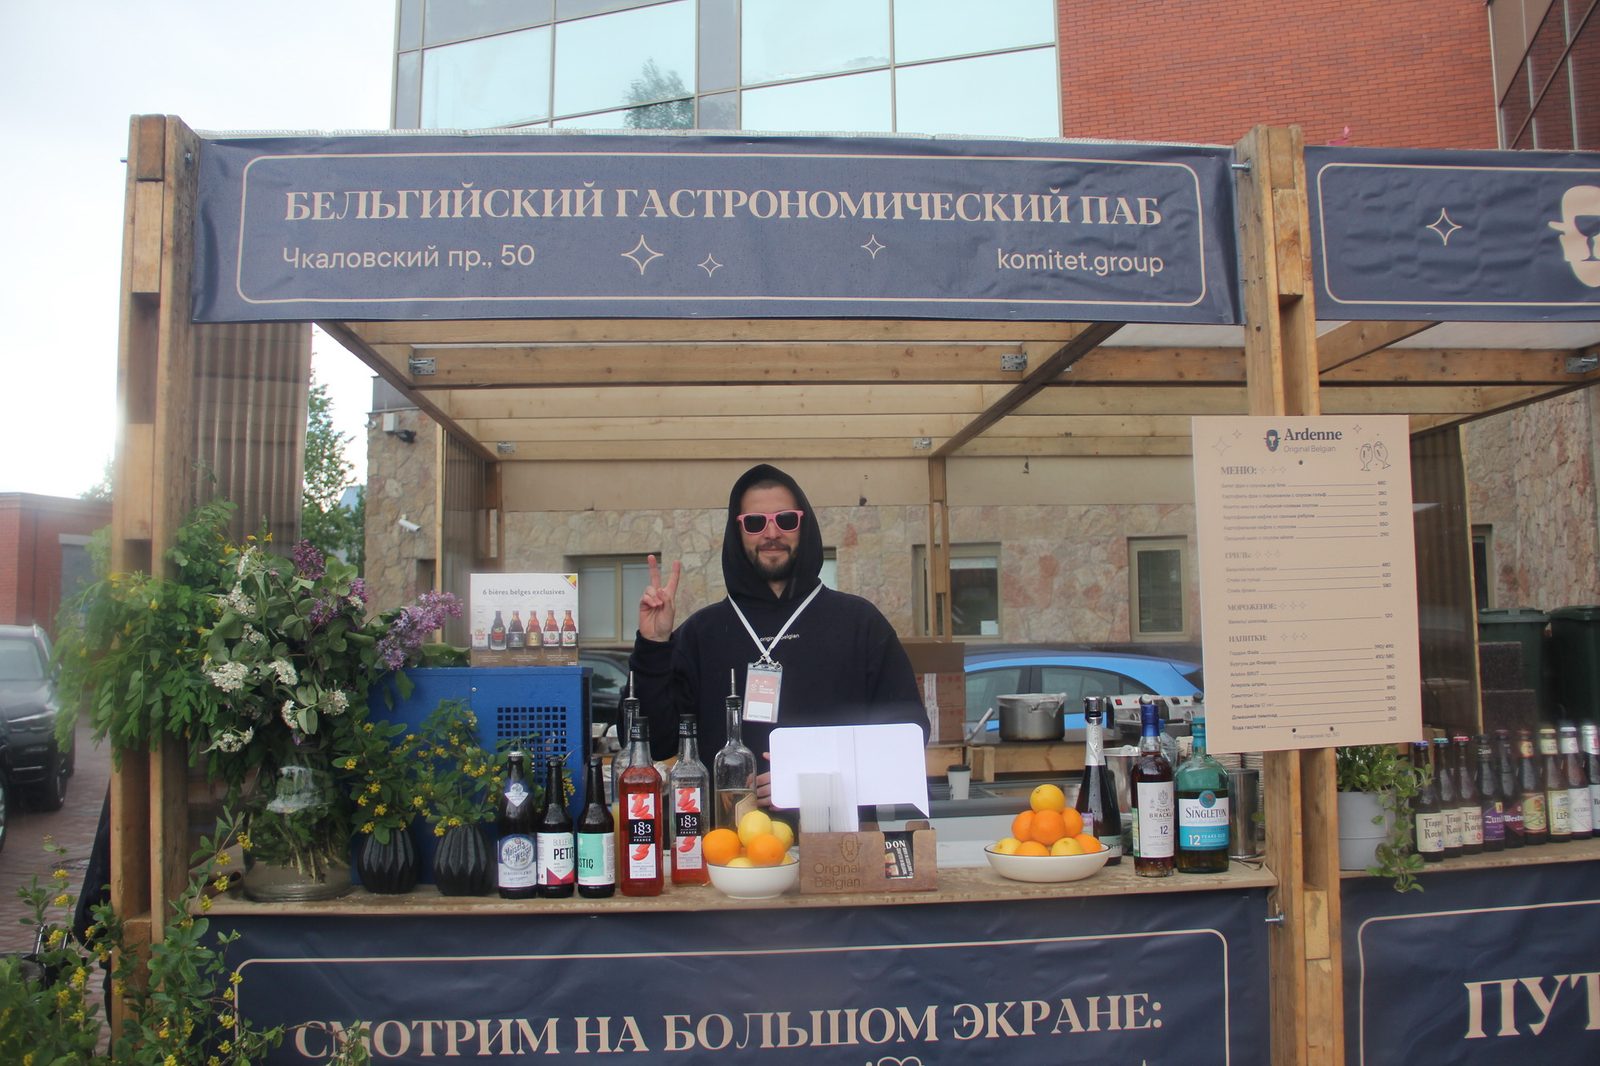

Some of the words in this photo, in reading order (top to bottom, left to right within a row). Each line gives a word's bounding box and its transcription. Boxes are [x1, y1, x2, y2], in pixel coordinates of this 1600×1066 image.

[284, 181, 604, 221] БЕЛЬГИЙСКИЙ
[615, 186, 1070, 224] ГАСТРОНОМИЧЕСКИЙ
[1080, 194, 1162, 226] ПАБ
[282, 245, 440, 270] Чкаловский
[448, 250, 492, 272] пр.,
[501, 244, 536, 267] 50
[998, 248, 1165, 277] komitet.group
[1284, 428, 1342, 441] Ardenne
[1283, 444, 1310, 454] Original
[1310, 444, 1336, 453] Belgian
[510, 589, 531, 597] belges
[1185, 806, 1227, 819] SINGLETON
[1160, 825, 1169, 835] 12
[885, 840, 906, 849] DON
[1188, 834, 1201, 846] 12
[814, 862, 861, 876] Original
[814, 877, 861, 890] Belgian
[1463, 972, 1600, 1039] ПУТ
[294, 1017, 561, 1058] СМОТРИМ
[575, 1015, 650, 1054] НА
[662, 1005, 939, 1051] БОЛЬШОМ
[952, 992, 1163, 1041] ЭКРАНЕ:
